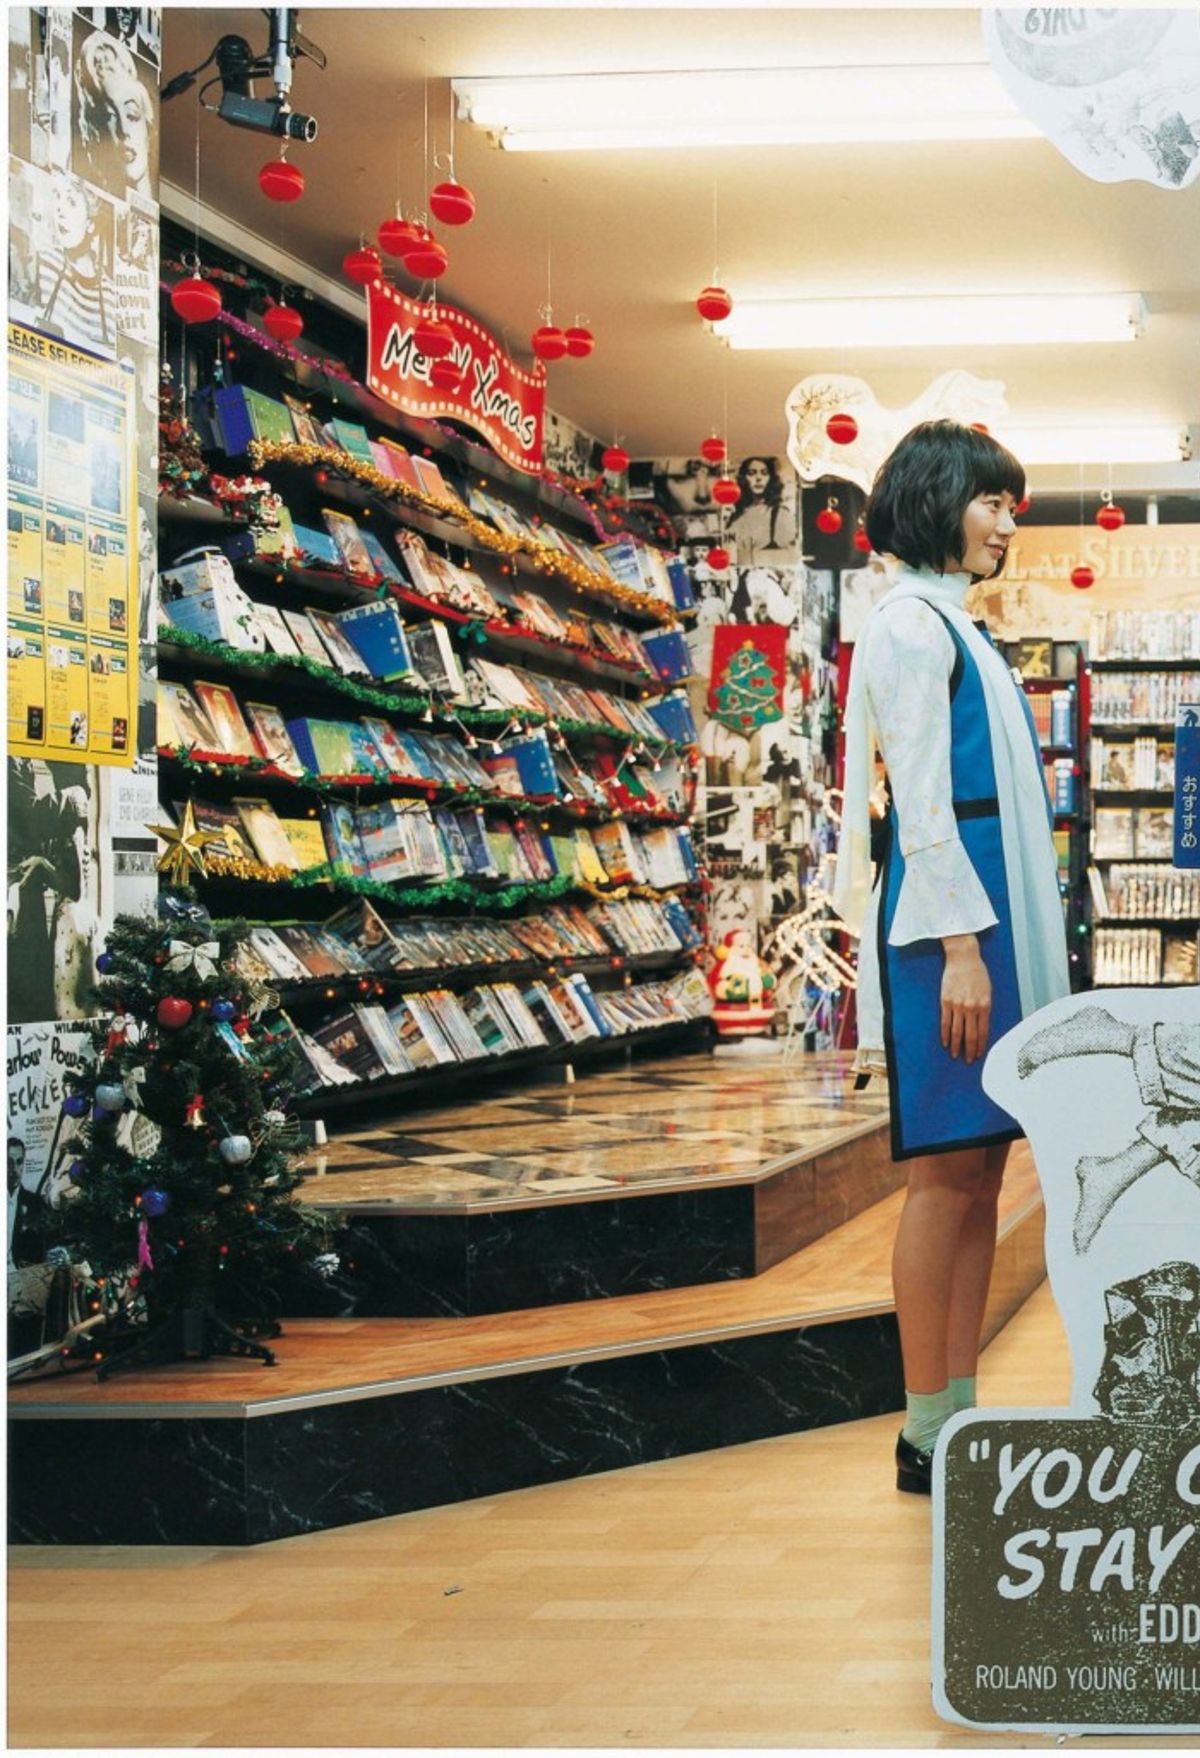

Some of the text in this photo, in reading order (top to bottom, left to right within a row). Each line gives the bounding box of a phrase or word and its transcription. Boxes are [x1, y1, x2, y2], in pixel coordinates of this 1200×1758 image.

[381, 322, 471, 395] Mey
[1181, 775, 1198, 849] おすすめ
[968, 1439, 1143, 1515] "YOU
[996, 1524, 1196, 1600] STAY
[1091, 1624, 1129, 1643] with
[975, 1665, 1057, 1690] ROLAND
[1066, 1666, 1137, 1691] YOUNG
